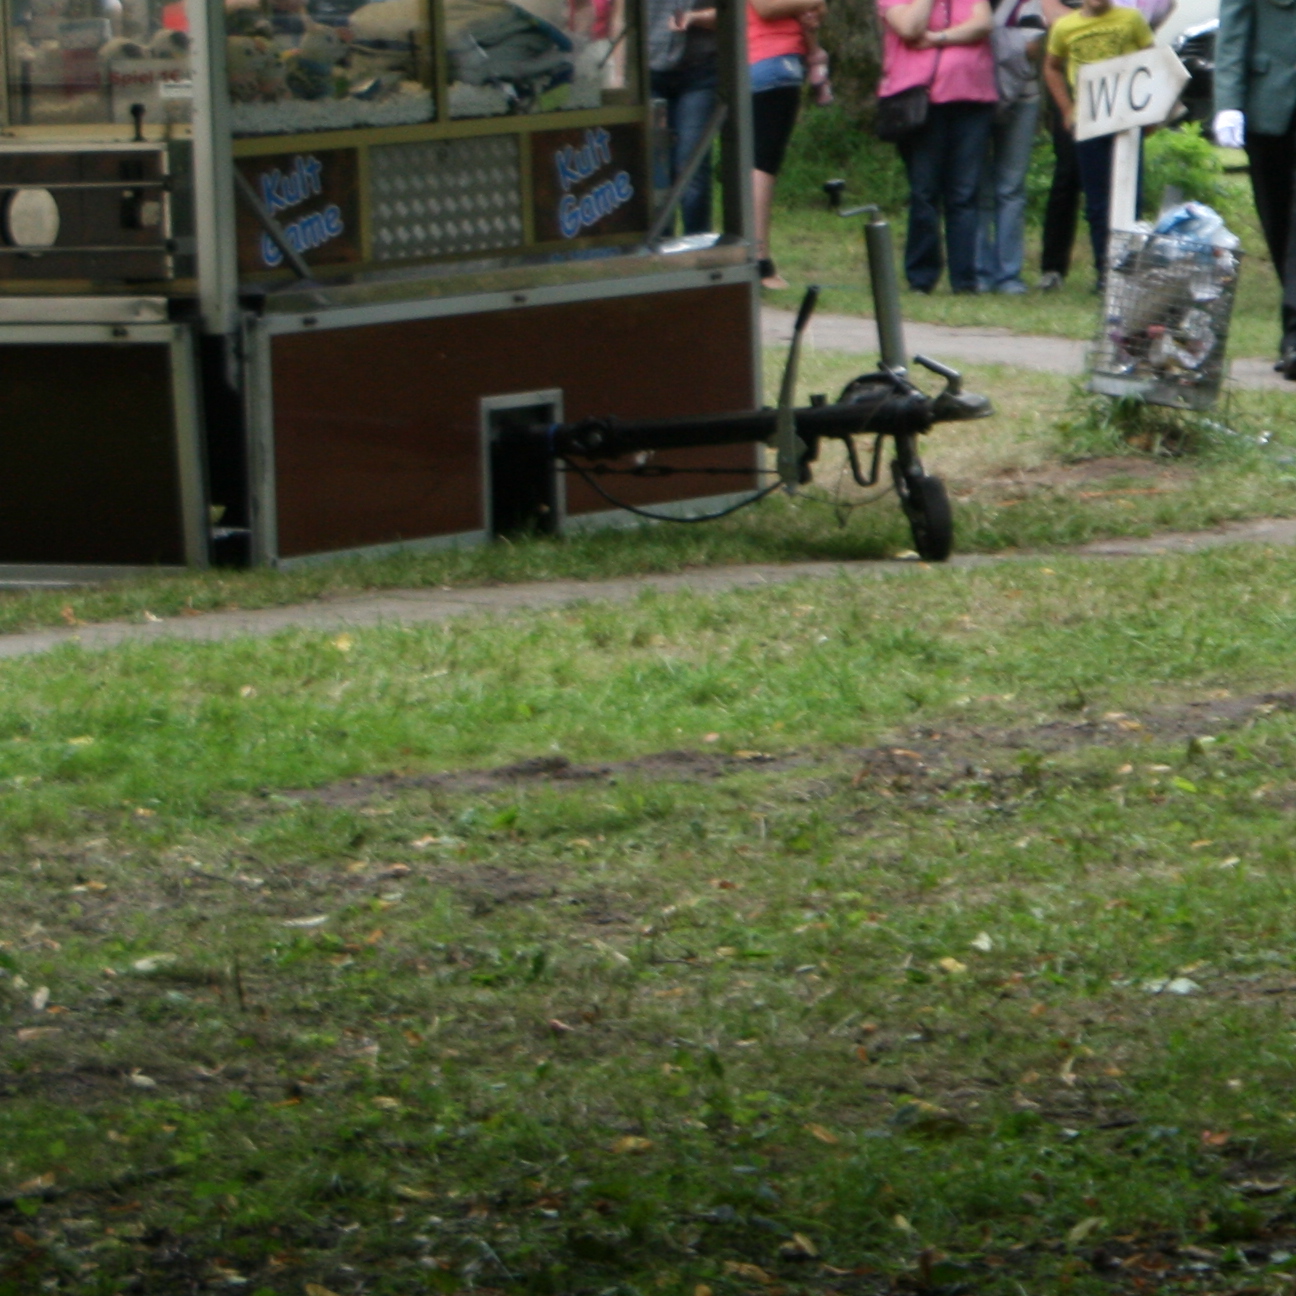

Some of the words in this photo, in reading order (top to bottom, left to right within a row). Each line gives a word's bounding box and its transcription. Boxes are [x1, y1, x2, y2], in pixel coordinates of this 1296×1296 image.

[1087, 65, 1153, 123] WC
[261, 155, 323, 217] Kult
[554, 127, 611, 193] Kult
[559, 170, 634, 239] Game
